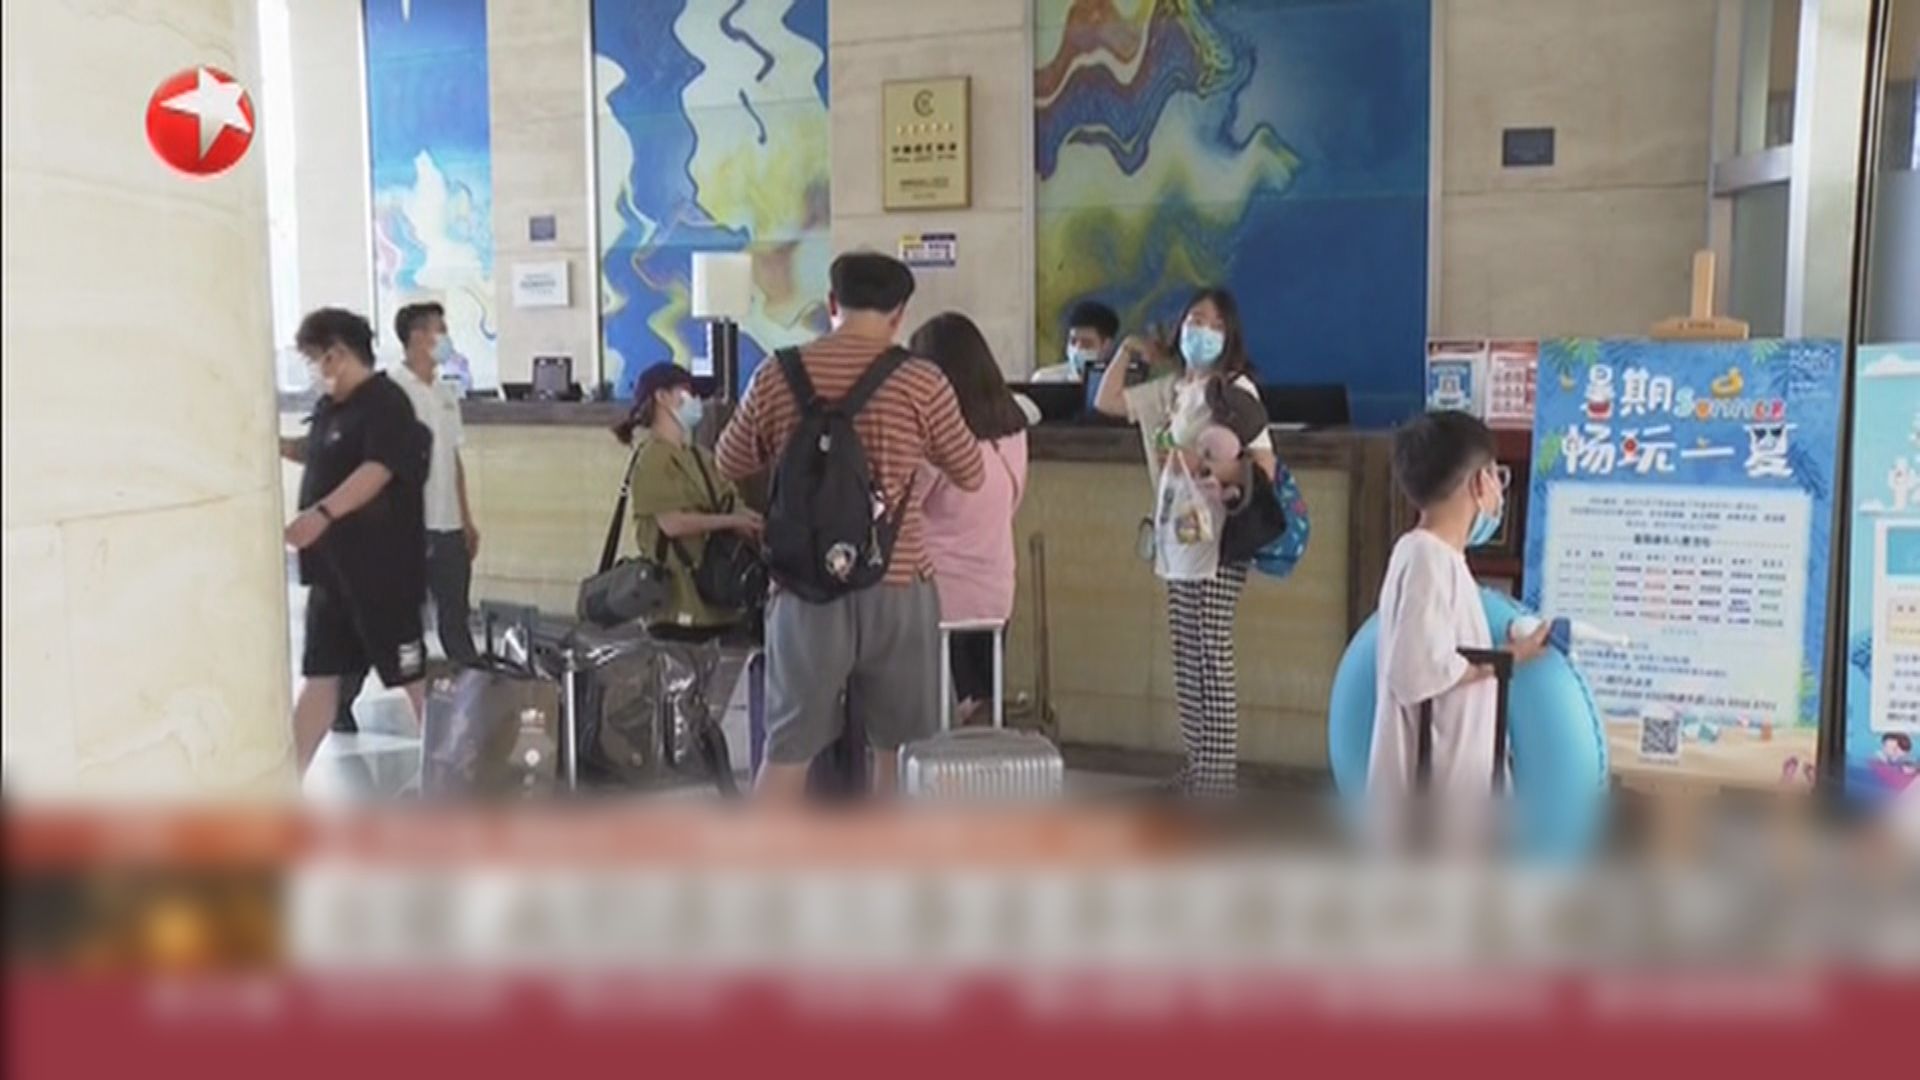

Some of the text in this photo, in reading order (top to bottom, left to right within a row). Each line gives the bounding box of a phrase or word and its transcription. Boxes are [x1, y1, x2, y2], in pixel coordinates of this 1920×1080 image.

[1580, 363, 1674, 420] 暑期
[1561, 422, 1799, 478] 畅玩一夏
